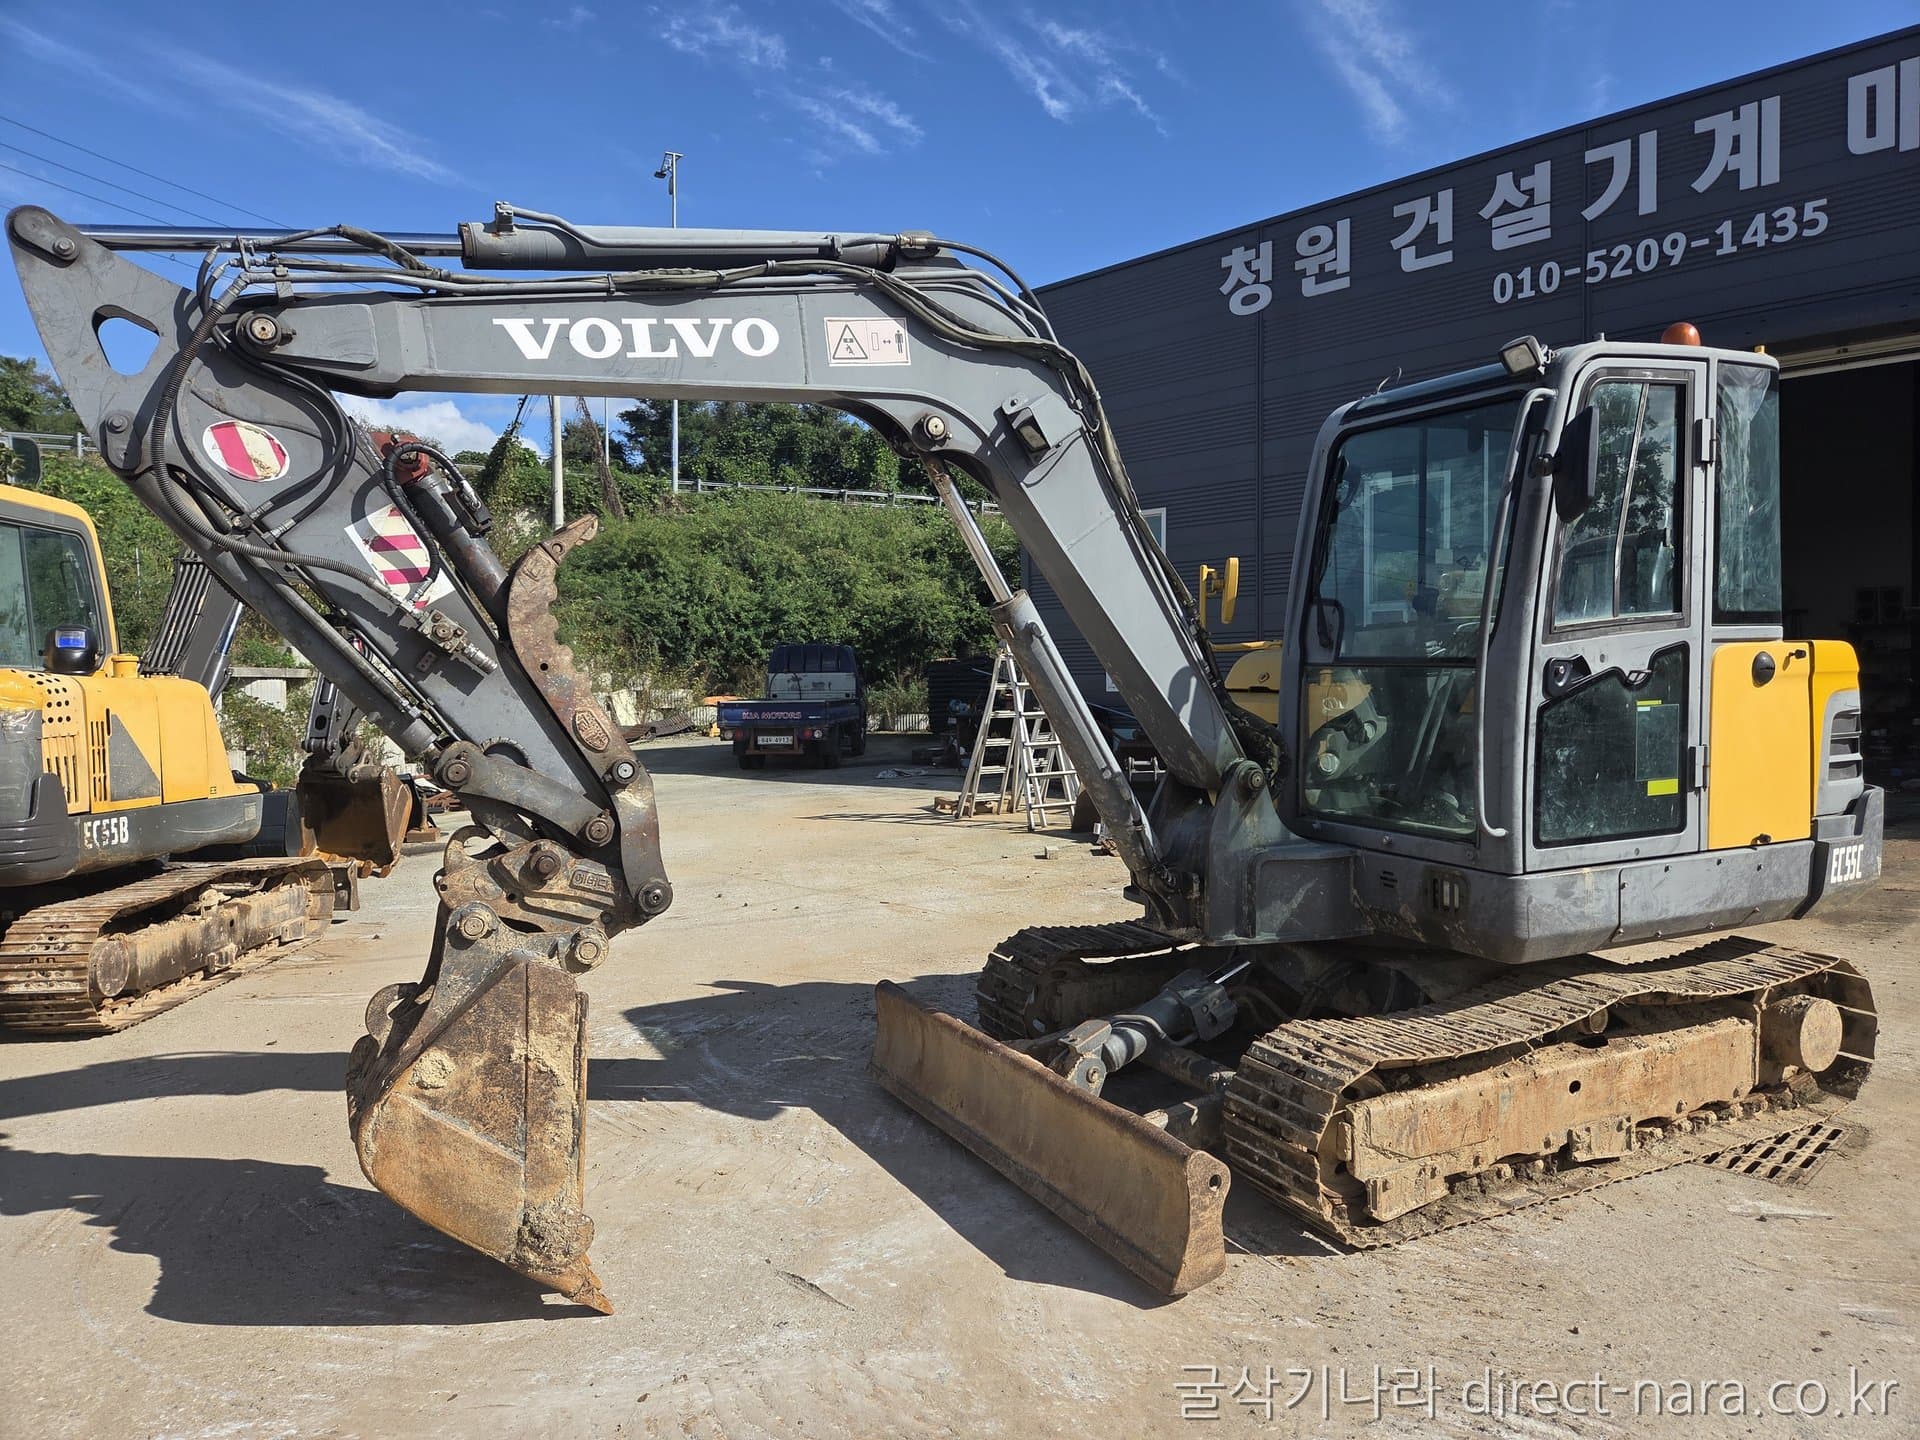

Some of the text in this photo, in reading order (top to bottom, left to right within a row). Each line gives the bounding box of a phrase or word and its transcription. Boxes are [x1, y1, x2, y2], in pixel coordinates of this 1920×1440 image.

[1492, 197, 1830, 304] 010-5209-1435
[492, 317, 780, 360] VOLVO
[742, 711, 802, 720] KIA MOTORS
[83, 816, 129, 849] EC55B
[1830, 844, 1865, 884] EC55C
